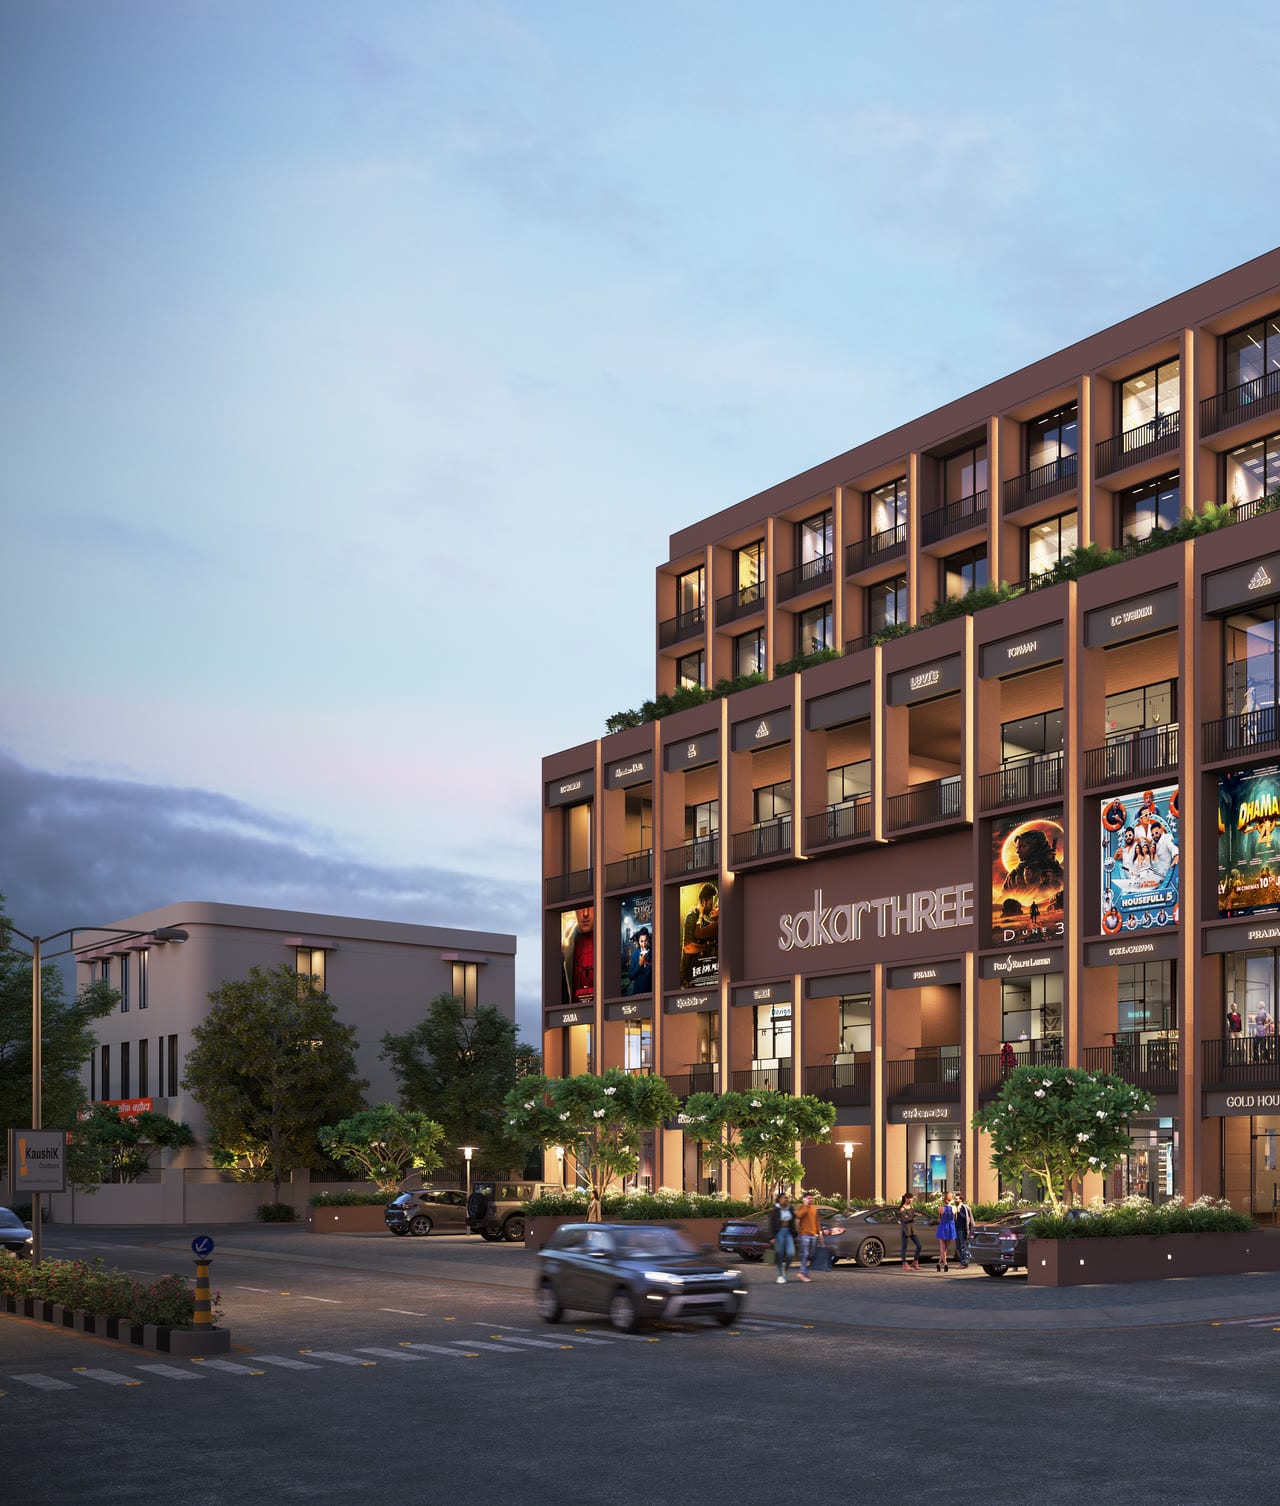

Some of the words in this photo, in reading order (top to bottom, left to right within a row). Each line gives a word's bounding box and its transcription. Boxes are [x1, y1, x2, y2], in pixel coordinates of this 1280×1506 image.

[1121, 895, 1164, 907] HOUSEFULL
[778, 888, 871, 951] sakar
[870, 883, 974, 938] THREE
[1003, 926, 1048, 942] DUNE
[1226, 1095, 1255, 1108] GOLD
[26, 1147, 59, 1160] KaushiK
